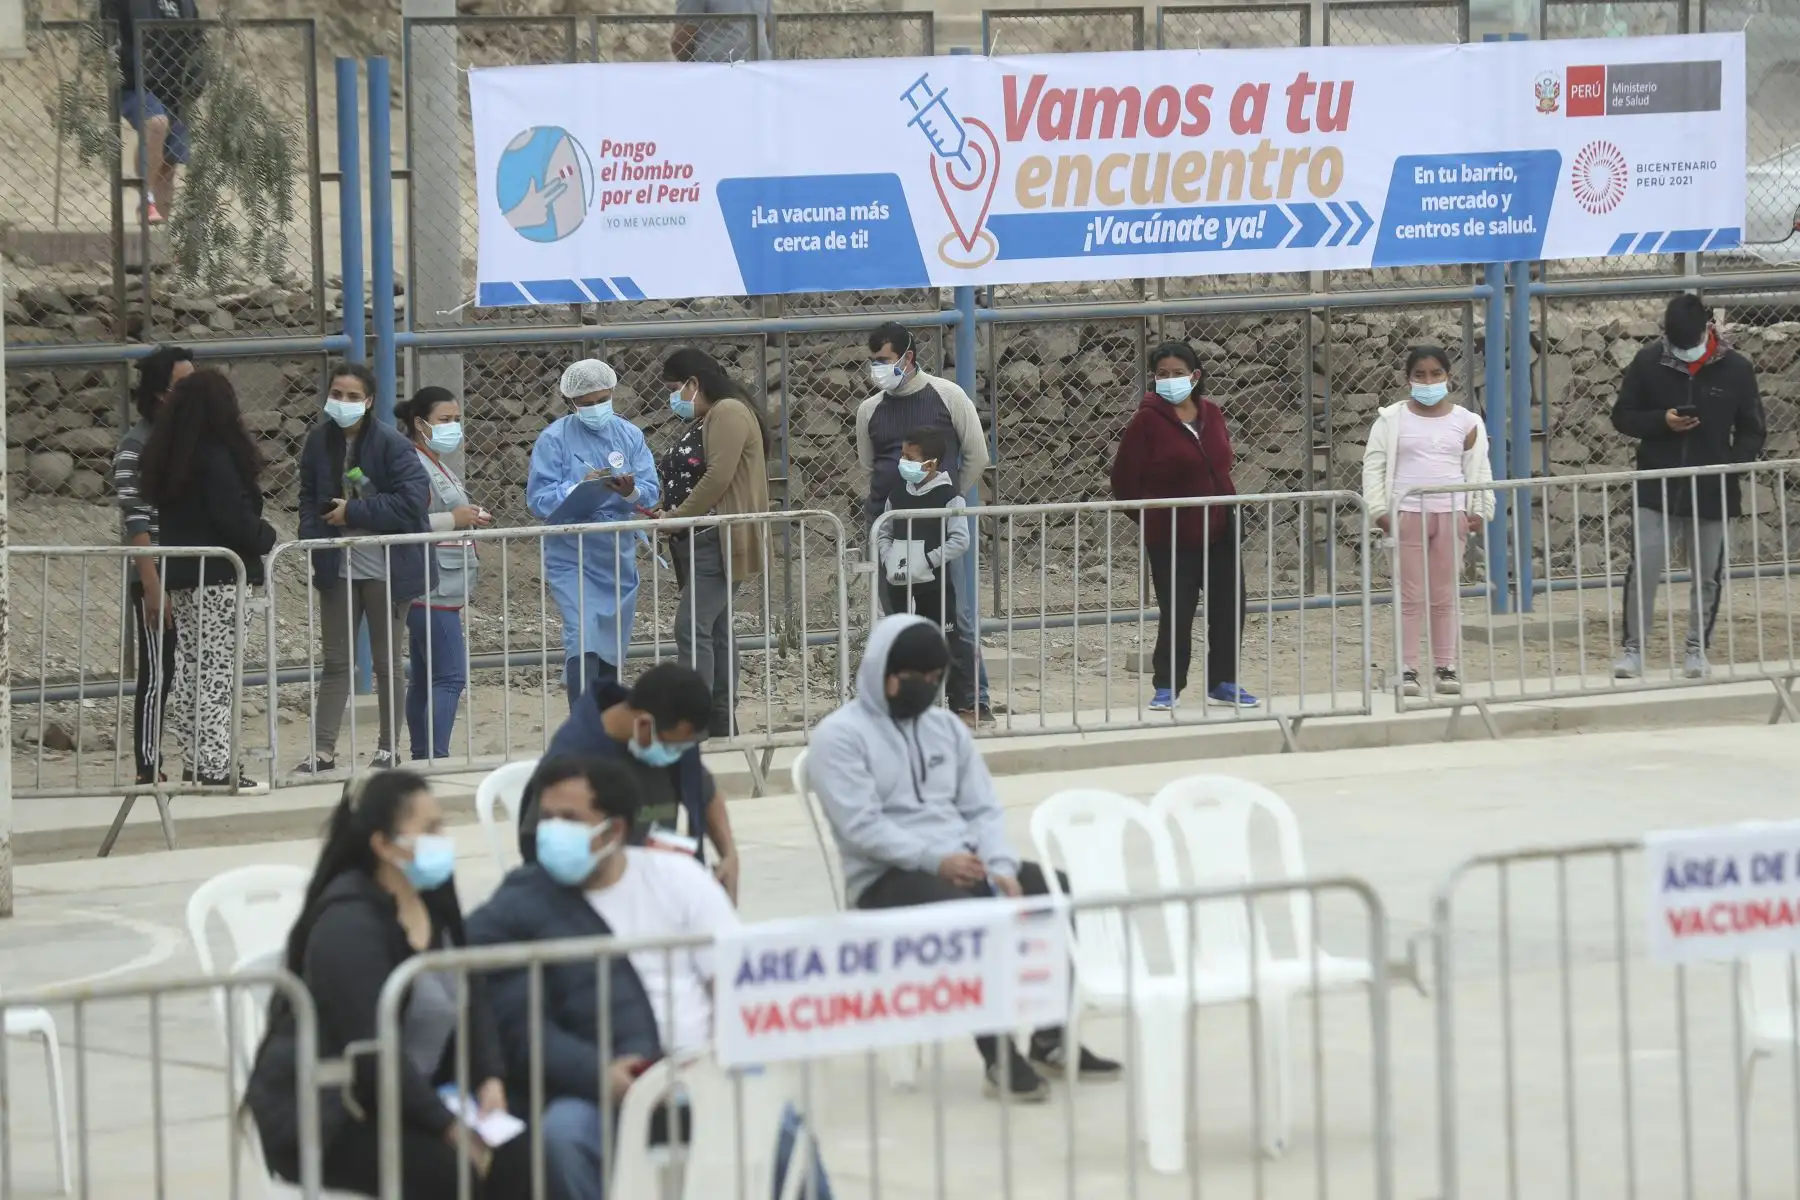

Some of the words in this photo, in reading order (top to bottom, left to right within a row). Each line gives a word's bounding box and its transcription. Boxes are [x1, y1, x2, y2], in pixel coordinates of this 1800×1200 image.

[1571, 81, 1601, 99] PERÚ
[1612, 81, 1657, 94] Ministerio
[1002, 74, 1214, 142] Vamos
[1229, 83, 1270, 135] a
[1286, 72, 1354, 133] tu
[1612, 97, 1623, 106] de
[1625, 95, 1649, 106] Salud
[600, 139, 656, 161] Pongo
[601, 163, 617, 181] el
[621, 160, 693, 180] hombro
[1015, 138, 1344, 209] encuentro
[1414, 166, 1434, 184] En
[1439, 166, 1457, 183] tu
[1461, 163, 1518, 184] barrio,
[1637, 160, 1717, 173] BICENTENARIO
[1637, 175, 1666, 187] PERÚ
[1669, 175, 1693, 186] 2021
[601, 187, 632, 211] por
[636, 183, 652, 203] el
[657, 181, 699, 203] Perú
[1422, 192, 1498, 211] mercado
[1501, 193, 1512, 213] y
[607, 217, 620, 228] YO
[624, 217, 638, 228] ME
[642, 216, 686, 227] VACUNO
[752, 206, 778, 228] ¡La
[782, 207, 846, 223] vacuna
[851, 201, 889, 221] más
[1083, 213, 1217, 252] ¡Vacúnate
[1222, 210, 1266, 246] ya!
[1396, 221, 1459, 239] centros
[1463, 217, 1484, 236] de
[1488, 215, 1537, 235] salud.
[774, 235, 820, 252] cerca
[824, 232, 847, 250] de
[851, 231, 868, 249] ti!
[1662, 853, 1741, 893] ÁREA
[1750, 851, 1786, 885] DE
[1665, 896, 1800, 939] VACUNA
[735, 947, 826, 987] ÁREA
[838, 939, 880, 974] DE
[891, 928, 986, 968] POST
[739, 974, 983, 1036] VACUNACIÓN
